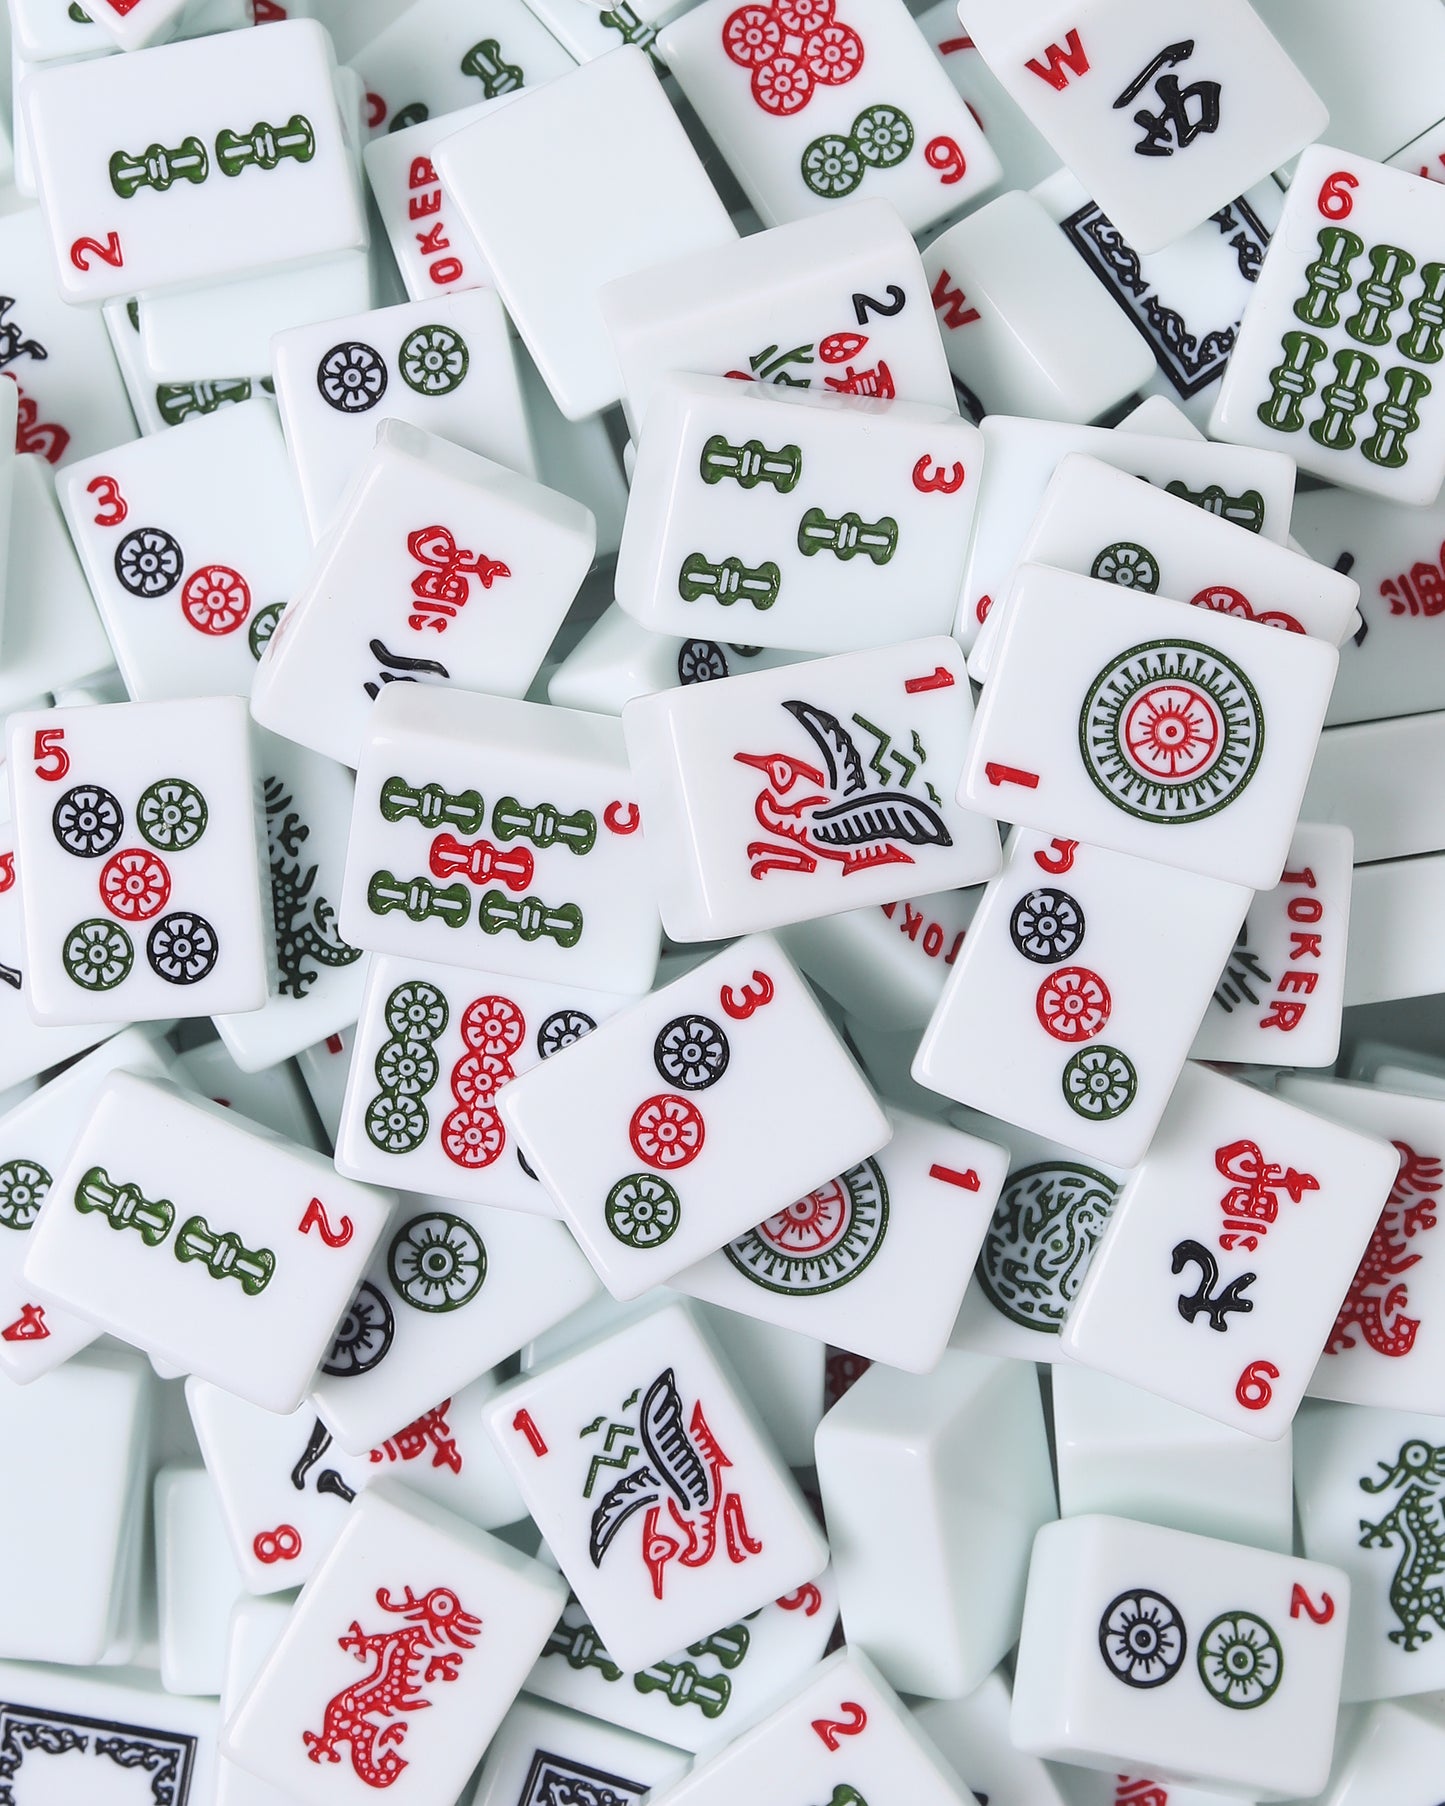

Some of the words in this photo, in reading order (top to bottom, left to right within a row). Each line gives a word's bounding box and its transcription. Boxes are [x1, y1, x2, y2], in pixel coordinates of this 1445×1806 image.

[1025, 28, 1091, 91] W
[1317, 171, 1360, 221] 6
[70, 231, 124, 272] 2
[851, 284, 906, 326] 2
[911, 453, 965, 495] 3
[86, 475, 128, 527] 3
[904, 666, 955, 694] 1
[33, 728, 71, 782] 5
[984, 761, 1040, 790] 1
[719, 970, 775, 1021] 3
[929, 1163, 981, 1193] 1
[298, 1197, 354, 1249] 2
[1, 1303, 51, 1342] 4
[512, 1408, 549, 1458] 1
[252, 1524, 302, 1565] 8
[1290, 1583, 1335, 1625] 2
[811, 1701, 868, 1752] 2
